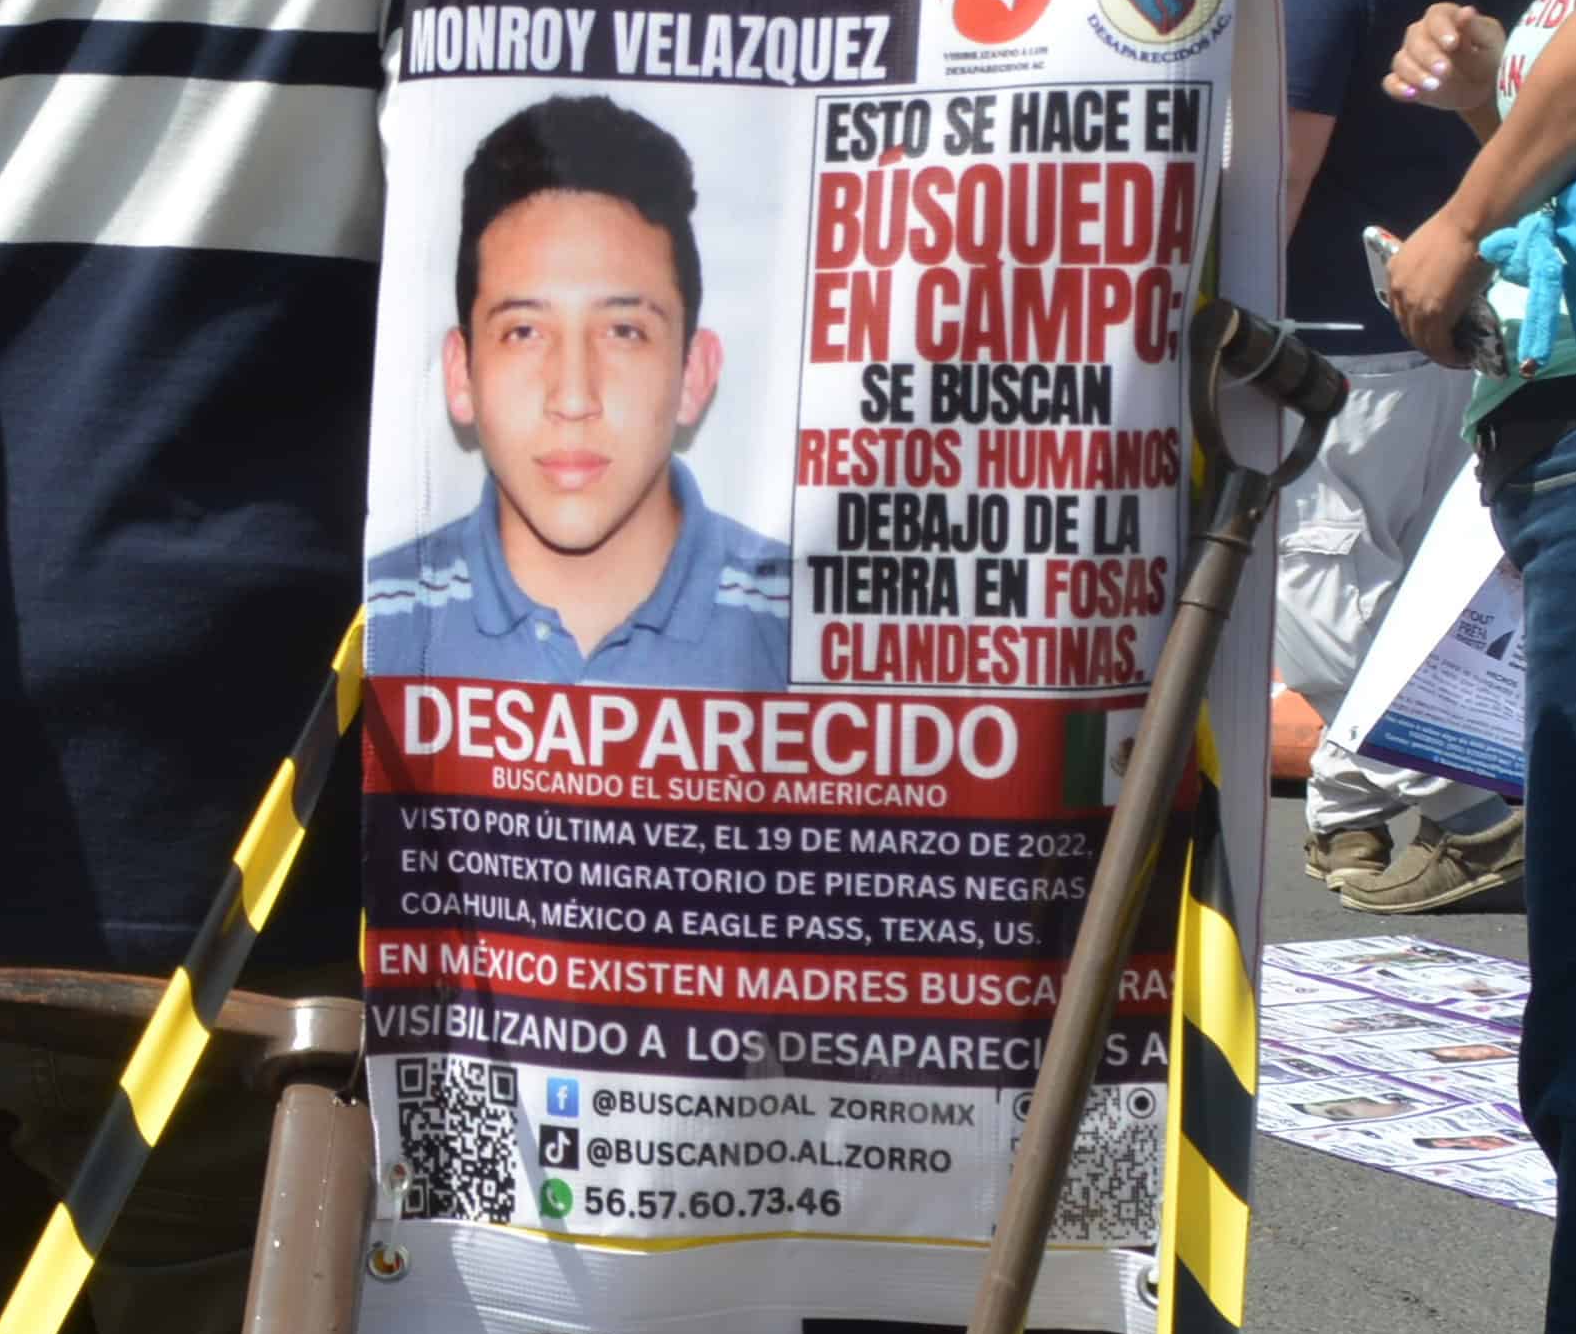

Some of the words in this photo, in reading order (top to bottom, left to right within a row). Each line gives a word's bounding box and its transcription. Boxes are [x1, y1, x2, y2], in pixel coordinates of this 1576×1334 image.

[409, 6, 596, 74] MONROY
[613, 10, 890, 86] VELAZQUEZ
[825, 98, 931, 162] ESTO
[944, 95, 997, 156] SE
[1010, 89, 1130, 154] HACE
[1145, 89, 1200, 153] EN
[815, 145, 1195, 269] BÚSQUEDA
[810, 268, 892, 364] EN
[860, 364, 914, 424] SE
[931, 364, 1112, 425] BUSCAN
[797, 428, 962, 488] RESTOS
[978, 427, 1179, 490] HUMANOS
[837, 493, 1010, 553] DEBAJO
[1024, 494, 1079, 554] DE
[1094, 494, 1140, 555] LA
[807, 555, 959, 616] TIERRA
[975, 558, 1028, 617] EN
[1045, 557, 1167, 620] FOSAS
[821, 621, 1144, 686] CLANDESTINAS.
[404, 684, 1018, 780] DESAPARECIDO
[492, 767, 622, 800] BUSCANDO
[631, 776, 660, 800] EL
[669, 772, 765, 804] SUEÑO
[773, 781, 947, 808] AMERICANO
[401, 807, 481, 833] VISTO
[486, 812, 530, 837] POR
[537, 810, 636, 844] ÚLTIMA
[644, 823, 706, 853] VEZ,
[715, 825, 749, 850] EL
[758, 827, 791, 852] 19
[801, 827, 842, 853] DE
[850, 829, 960, 857] MARZO
[971, 832, 1010, 857] DE
[401, 850, 439, 872] EN
[448, 851, 573, 883] CONTEXTO
[580, 862, 766, 895] MIGRATORIO
[776, 872, 816, 896] DE
[825, 873, 956, 899] PIEDRAS
[401, 893, 536, 927] COAHUILA,
[542, 899, 646, 933] MÉXICO
[654, 911, 674, 934] A
[682, 912, 776, 939] EAGLE
[787, 915, 872, 943] PASS,
[880, 917, 985, 949] TEXAS,
[994, 922, 1042, 945] US.
[379, 944, 428, 975] EN
[441, 940, 558, 985] MÉXICO
[567, 959, 724, 998] EXISTEN
[738, 967, 908, 1003] MADRES
[920, 970, 1174, 1007] BUSCARA
[372, 1003, 629, 1055] VISIBILIZANDO
[640, 1025, 666, 1059] A
[688, 1028, 765, 1062] LOS
[779, 1032, 1129, 1071] DESAPARECIS
[830, 1097, 975, 1127] ZORROMX
[587, 1138, 952, 1173] @BUSCANDO.AL.ZORRO
[585, 1186, 841, 1220] 56.57.60.73.46
